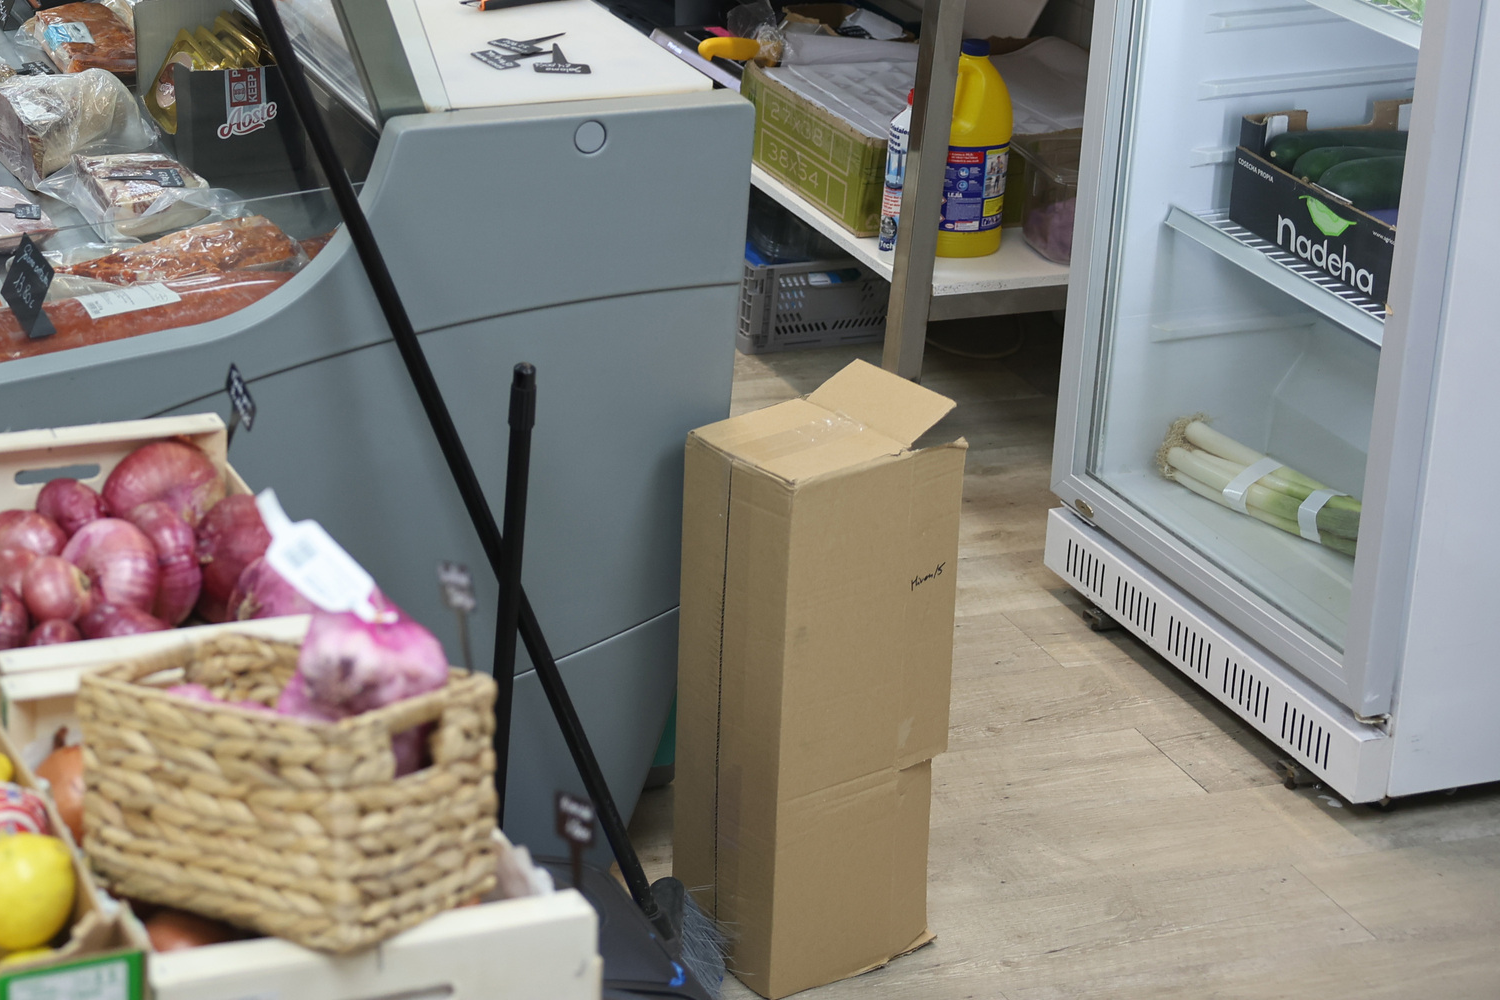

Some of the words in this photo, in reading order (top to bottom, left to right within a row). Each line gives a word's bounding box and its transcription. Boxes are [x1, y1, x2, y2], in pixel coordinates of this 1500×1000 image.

[217, 101, 278, 139] Aoste
[1237, 157, 1258, 176] COSECHA
[1257, 168, 1274, 184] PROPIA
[1276, 213, 1374, 296] nadeha
